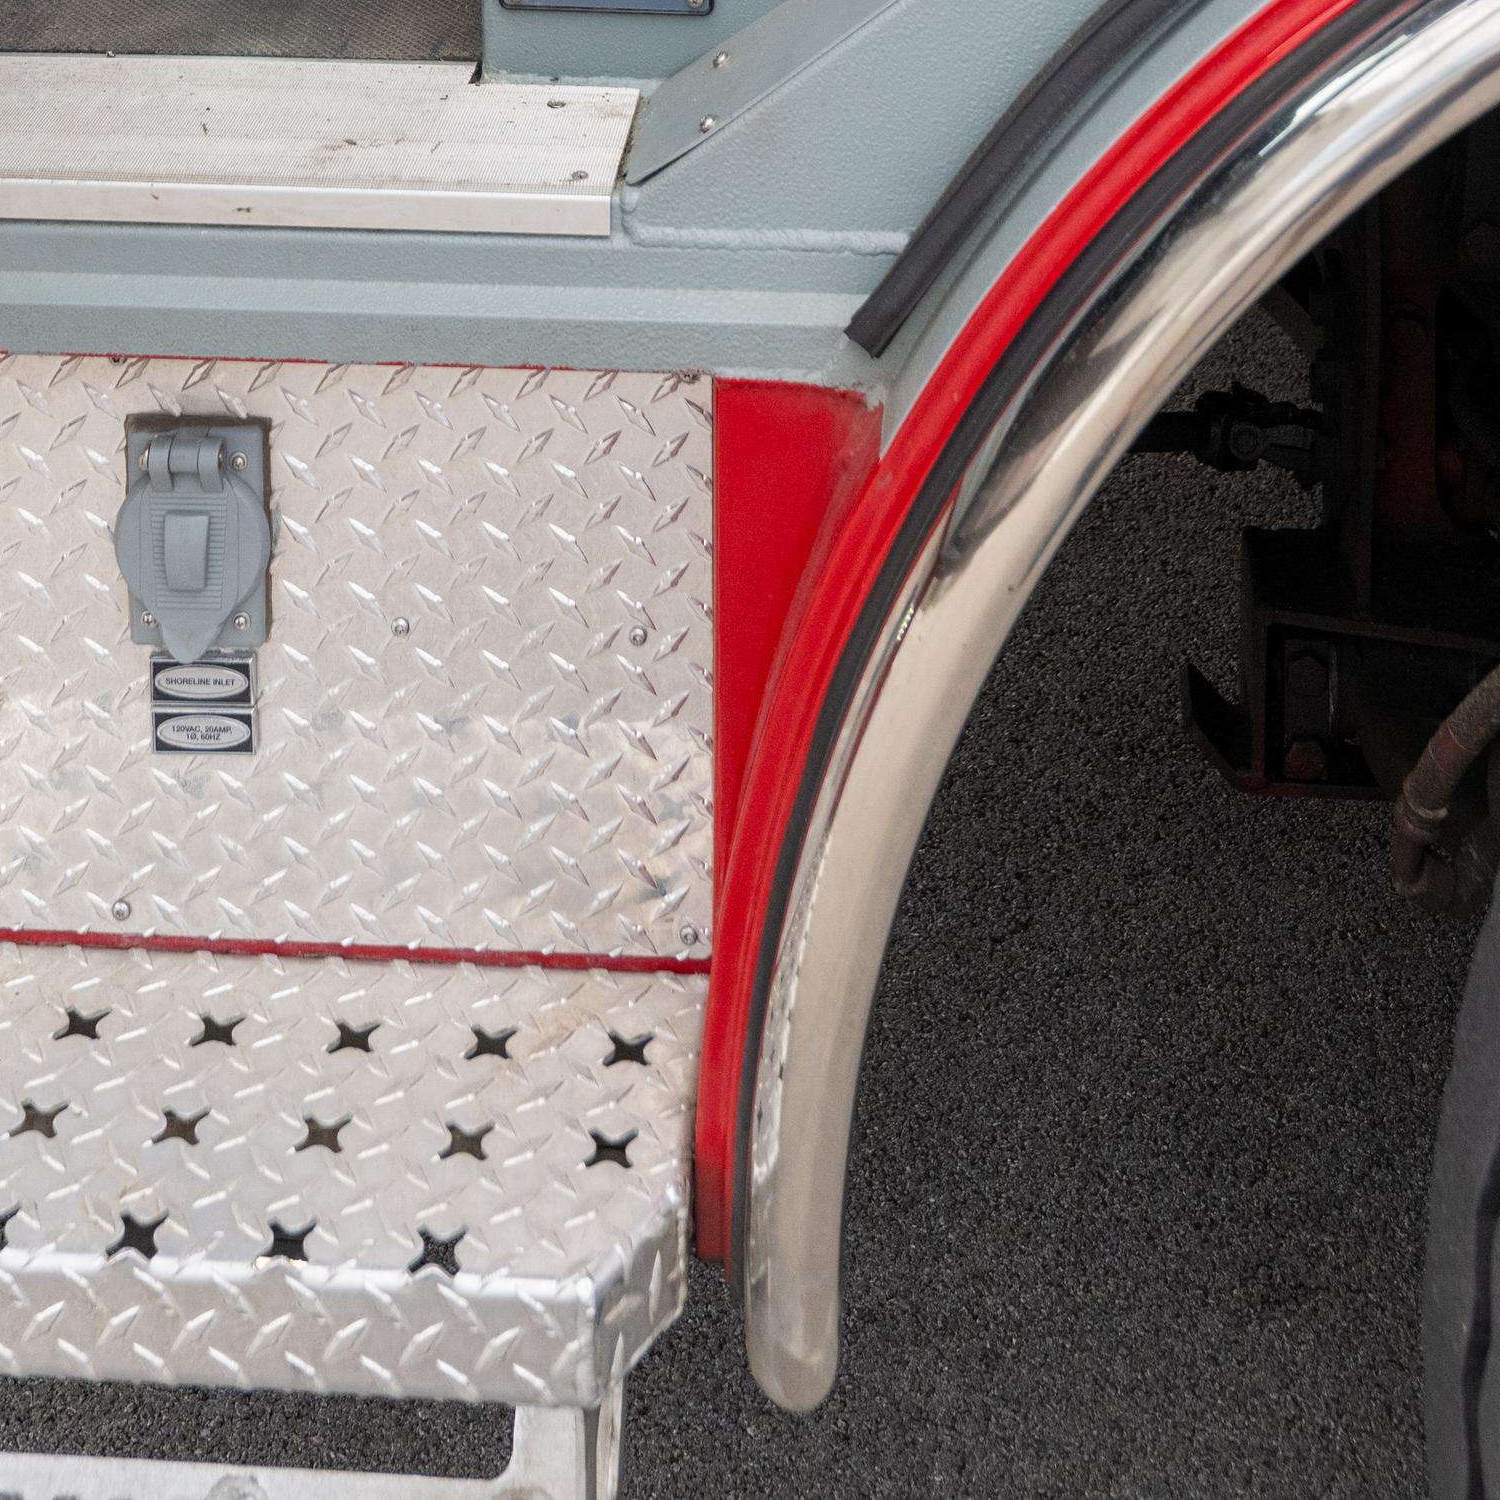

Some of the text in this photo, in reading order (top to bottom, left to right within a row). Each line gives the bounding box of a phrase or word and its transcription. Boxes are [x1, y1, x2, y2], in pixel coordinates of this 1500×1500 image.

[165, 677, 236, 686] SHORELINE INLET
[200, 733, 221, 741] 60HZ
